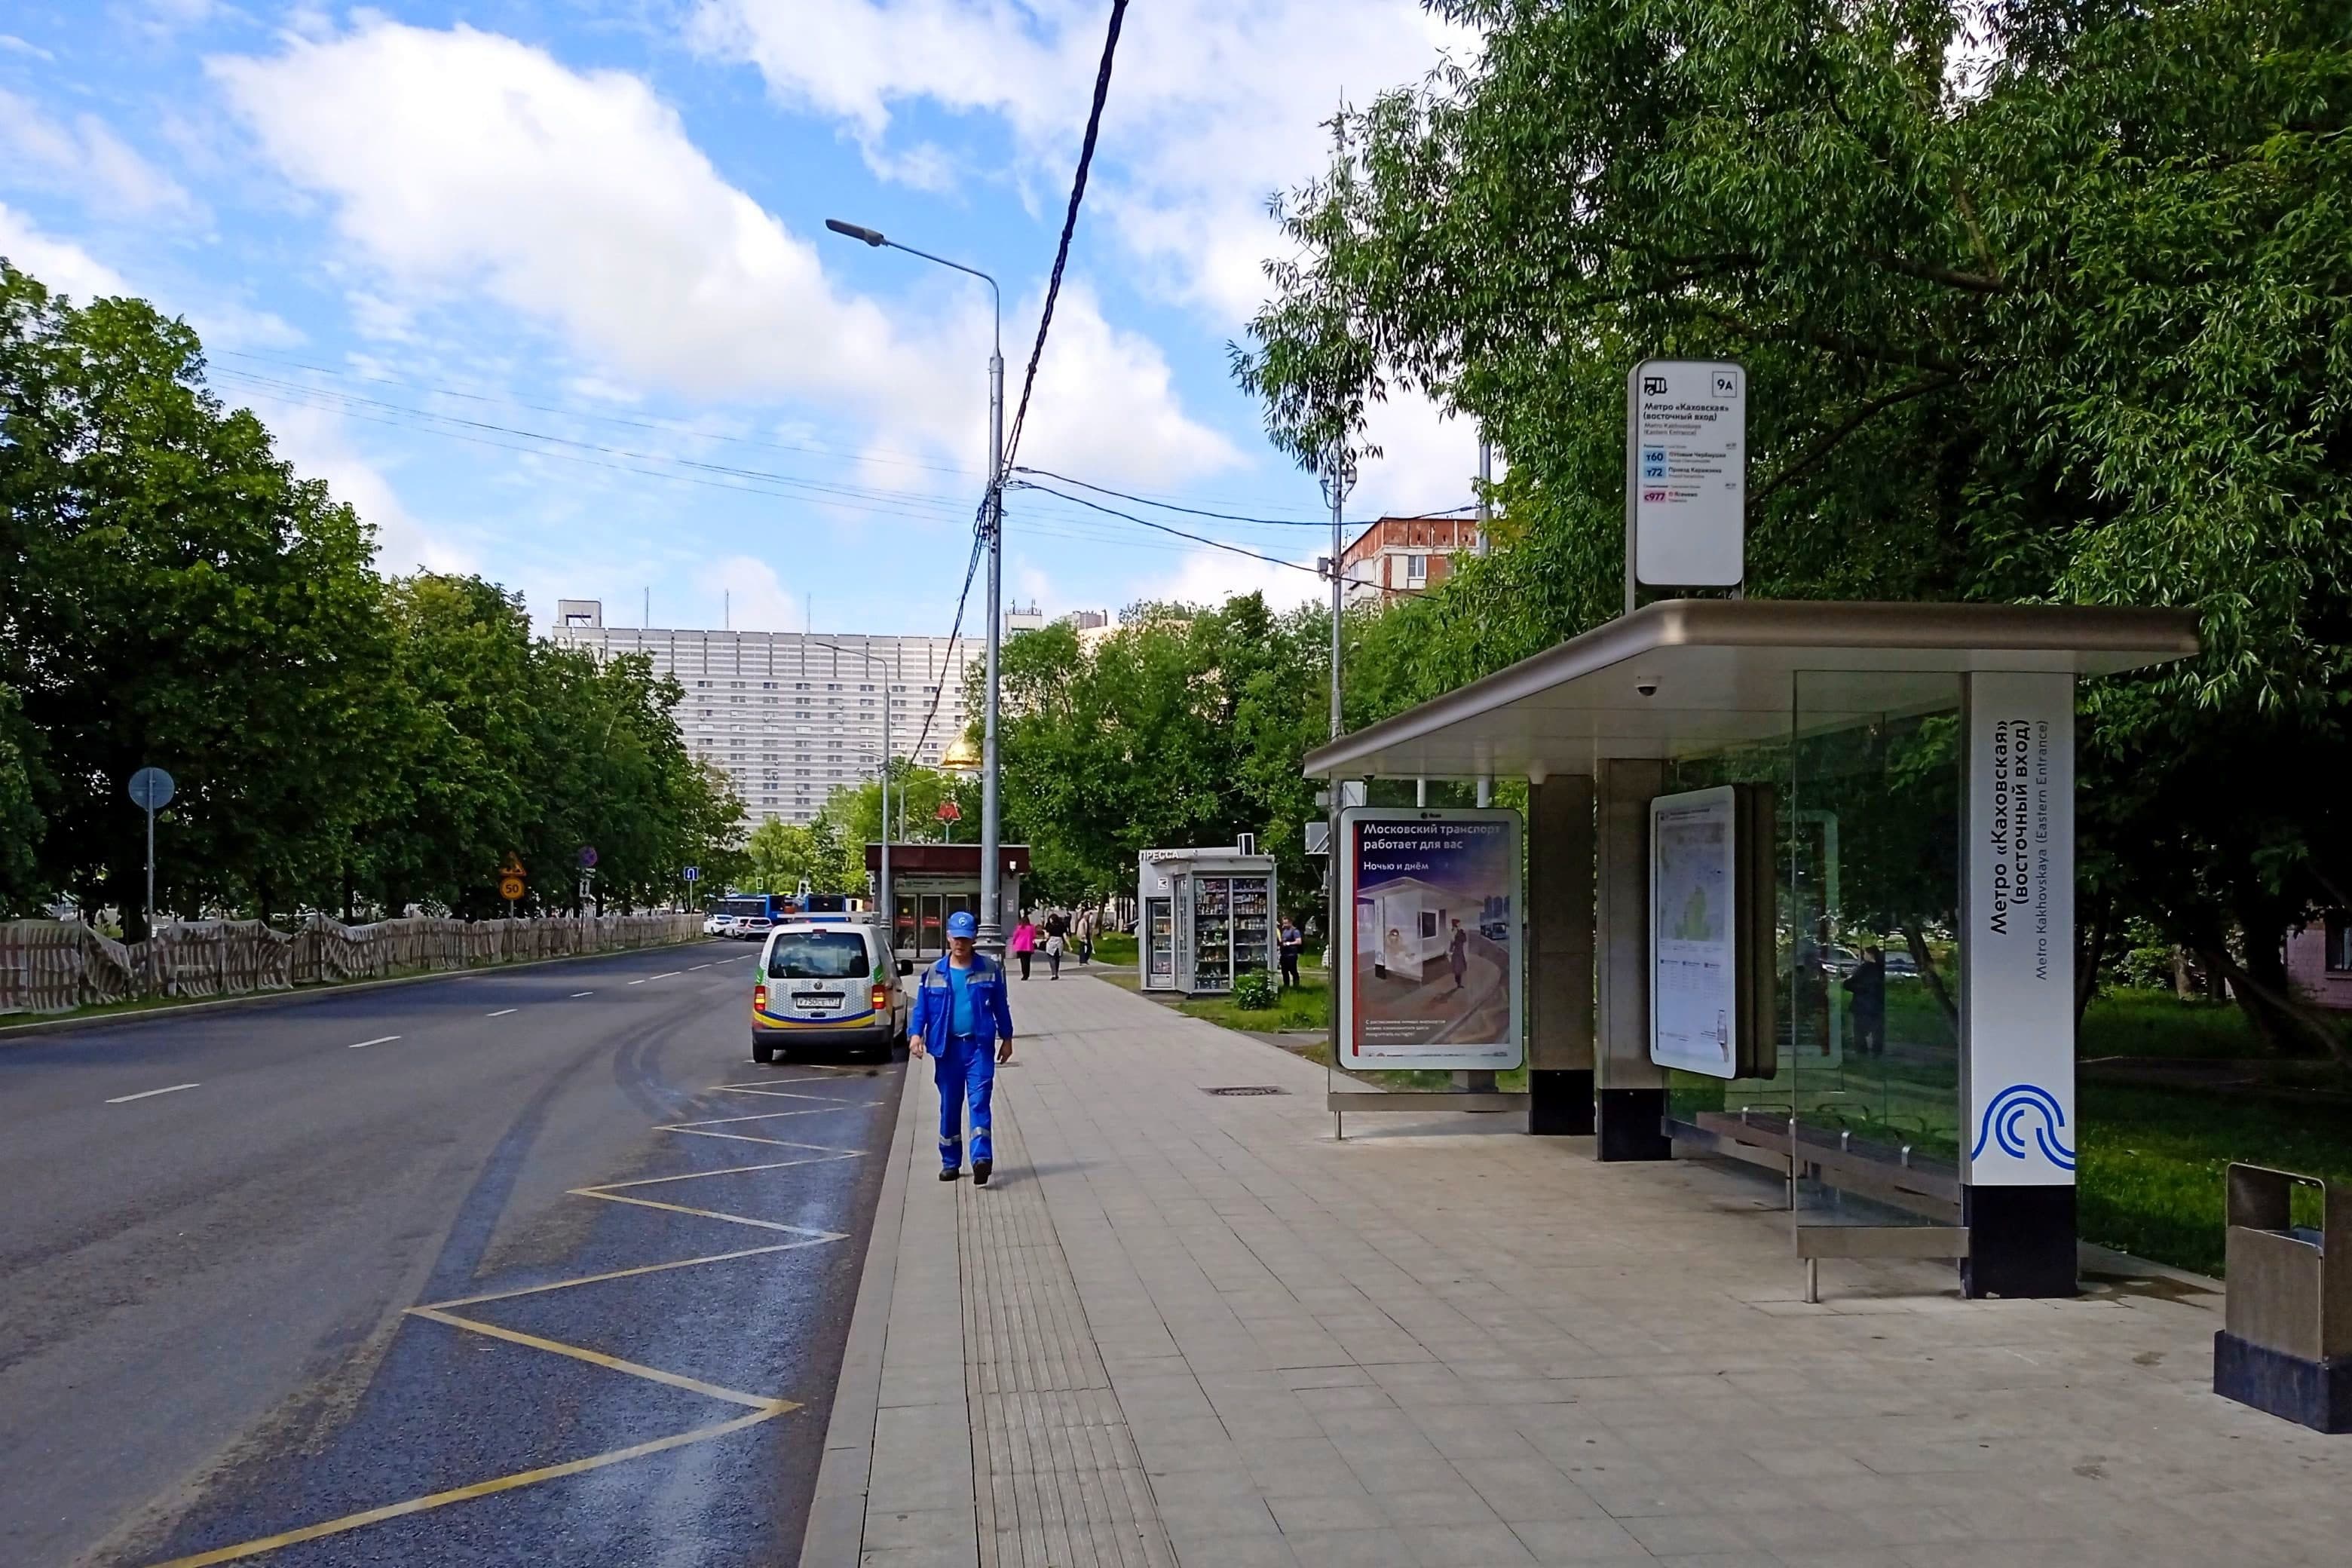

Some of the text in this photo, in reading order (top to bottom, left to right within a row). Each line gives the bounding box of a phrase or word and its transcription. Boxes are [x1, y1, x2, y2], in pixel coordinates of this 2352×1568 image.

[1717, 378, 1732, 390] 9А
[1644, 403, 1729, 412] Метро «Каховская»
[1643, 411, 1717, 421] (восточный вход)
[1646, 452, 1664, 461] т60
[1647, 467, 1663, 476] т72
[1644, 493, 1665, 501] с977
[2010, 720, 2030, 905] (восточный вход)
[1364, 823, 1500, 836] Московский транспорт
[1990, 720, 2011, 935] Метро «Каховская»
[1364, 838, 1463, 851] работает для вас
[1138, 850, 1180, 861] ПРЕССА
[2035, 721, 2049, 980] Metro Kakhovskaya (Eastern Entrance)
[1364, 861, 1395, 870] Ночью
[1404, 862, 1429, 871] днём
[506, 884, 519, 893] 50
